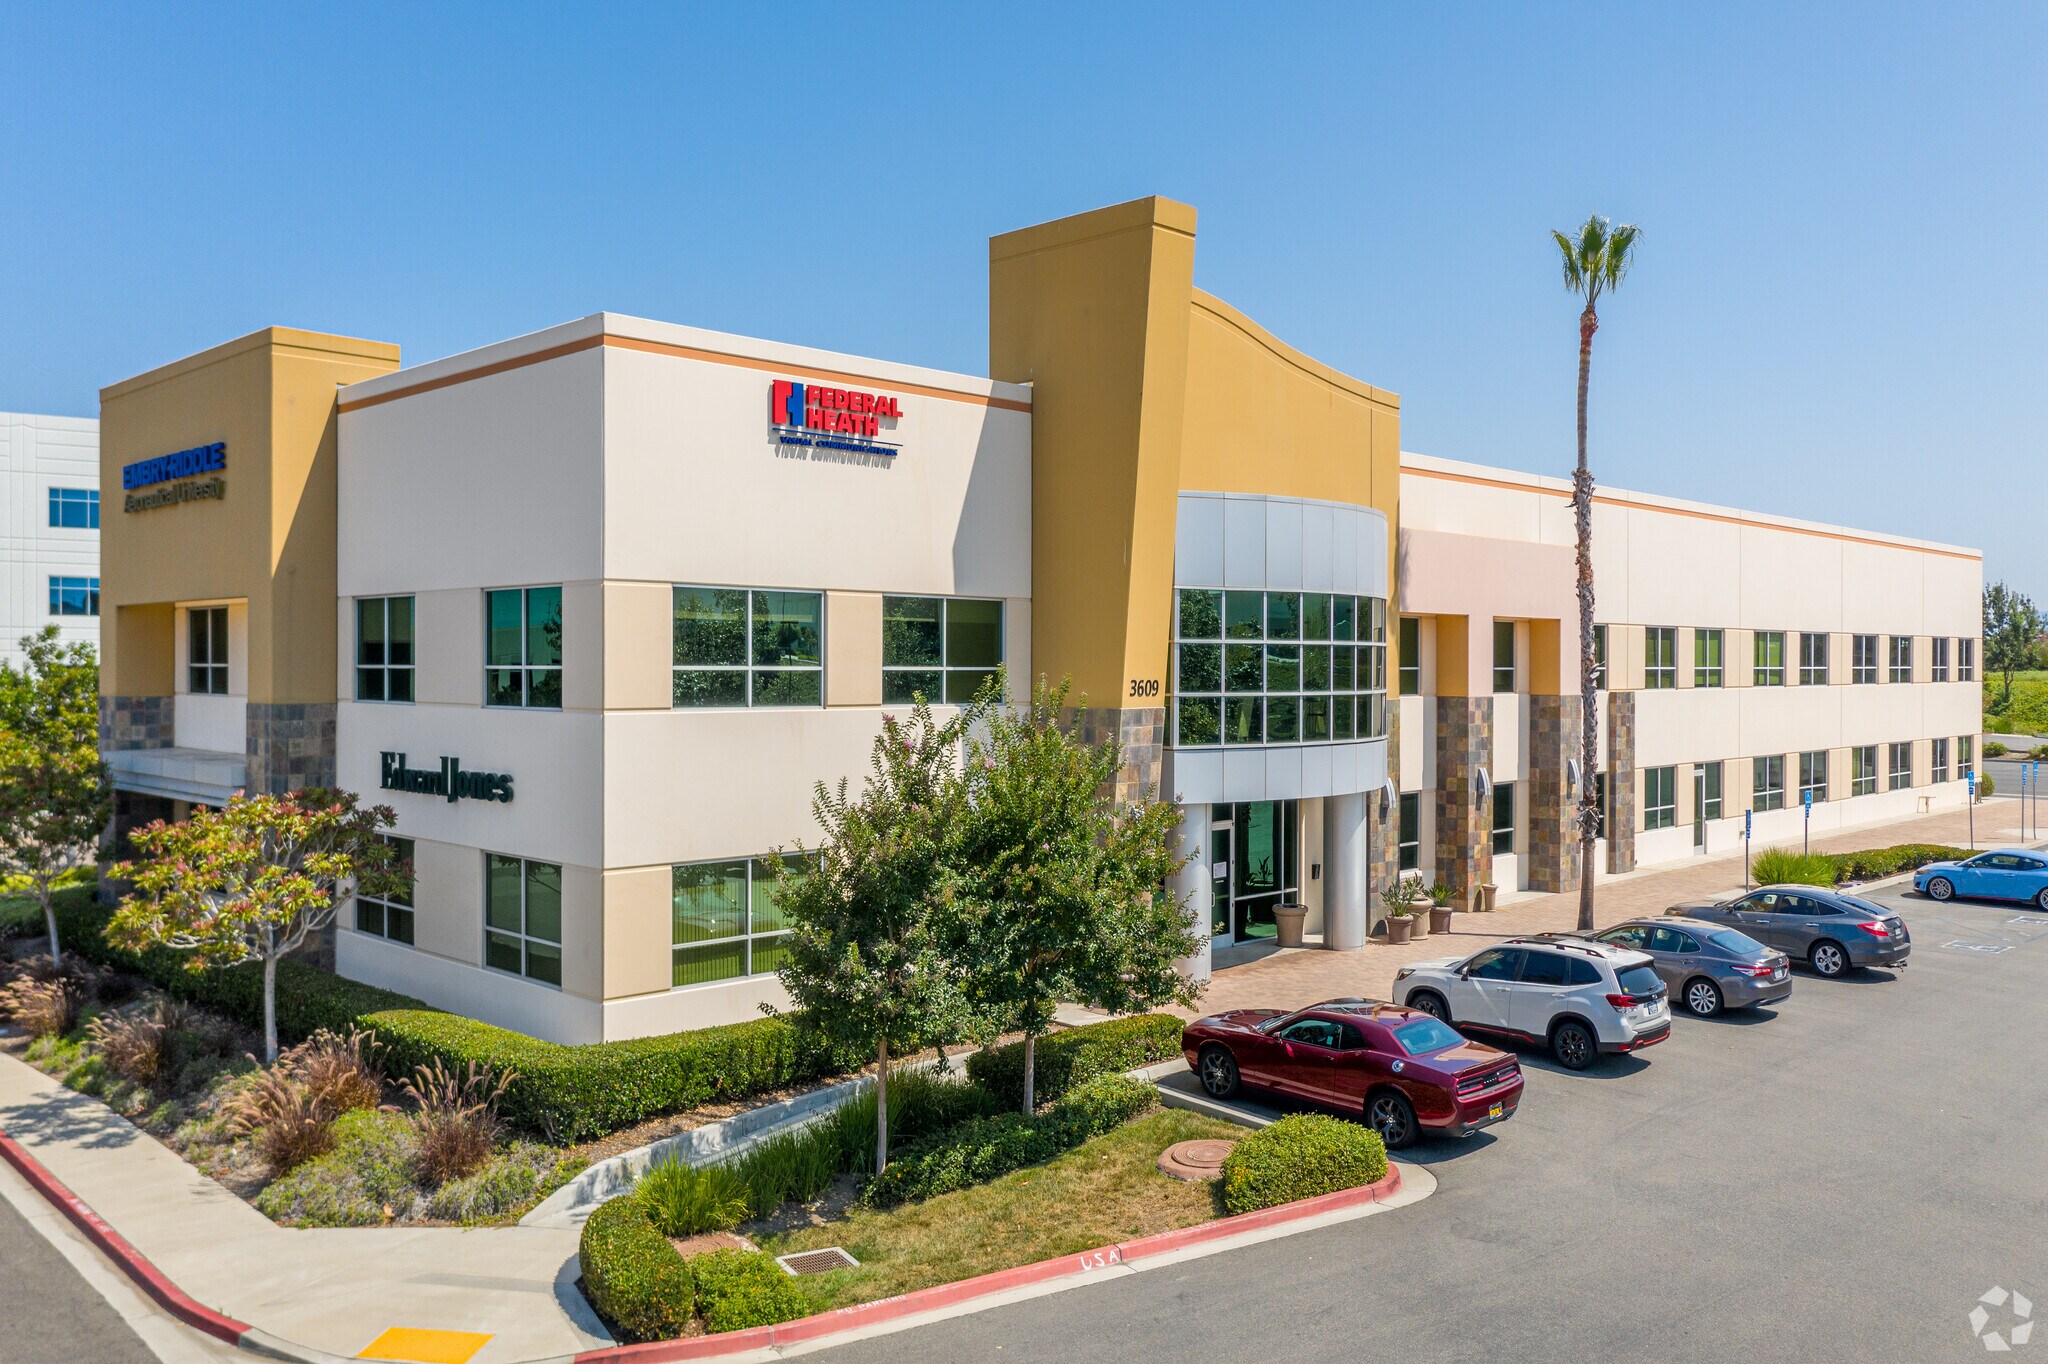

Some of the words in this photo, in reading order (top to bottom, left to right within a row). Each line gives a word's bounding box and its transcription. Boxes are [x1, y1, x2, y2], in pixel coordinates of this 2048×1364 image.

[806, 385, 903, 417] FEDERAL
[806, 408, 879, 436] HEATH
[780, 436, 814, 447] VISUAL
[123, 442, 226, 490] EMBRY-RIDDLE
[1129, 679, 1159, 697] 3609
[1080, 1250, 1121, 1271] USA
